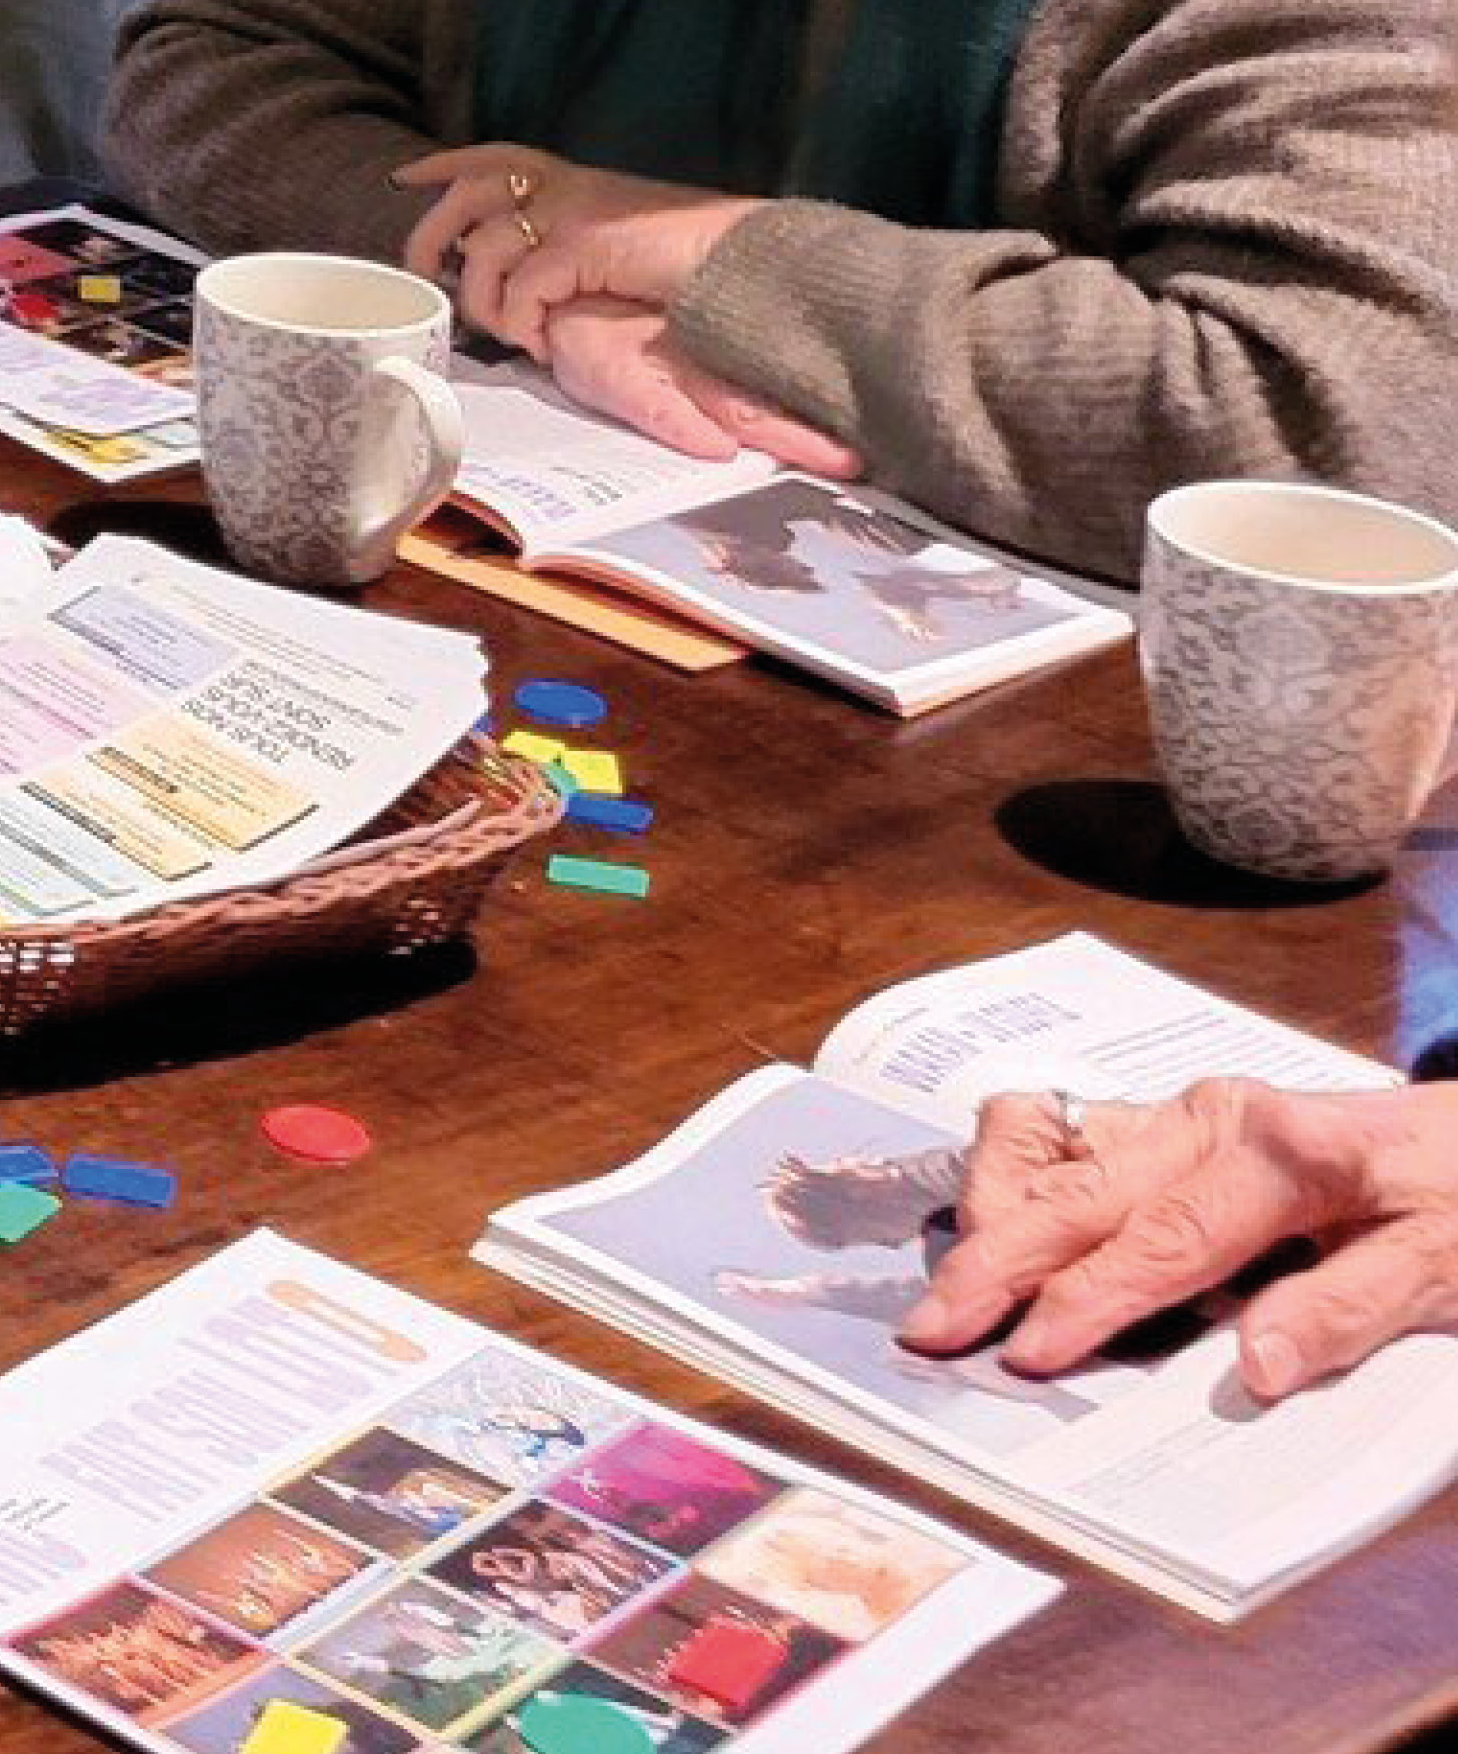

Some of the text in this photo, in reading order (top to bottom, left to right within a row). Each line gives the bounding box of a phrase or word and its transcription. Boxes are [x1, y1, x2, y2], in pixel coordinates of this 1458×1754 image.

[176, 1279, 428, 1414] LOTO
[128, 1367, 314, 1466] SON
[37, 1420, 219, 1524] FAIT
